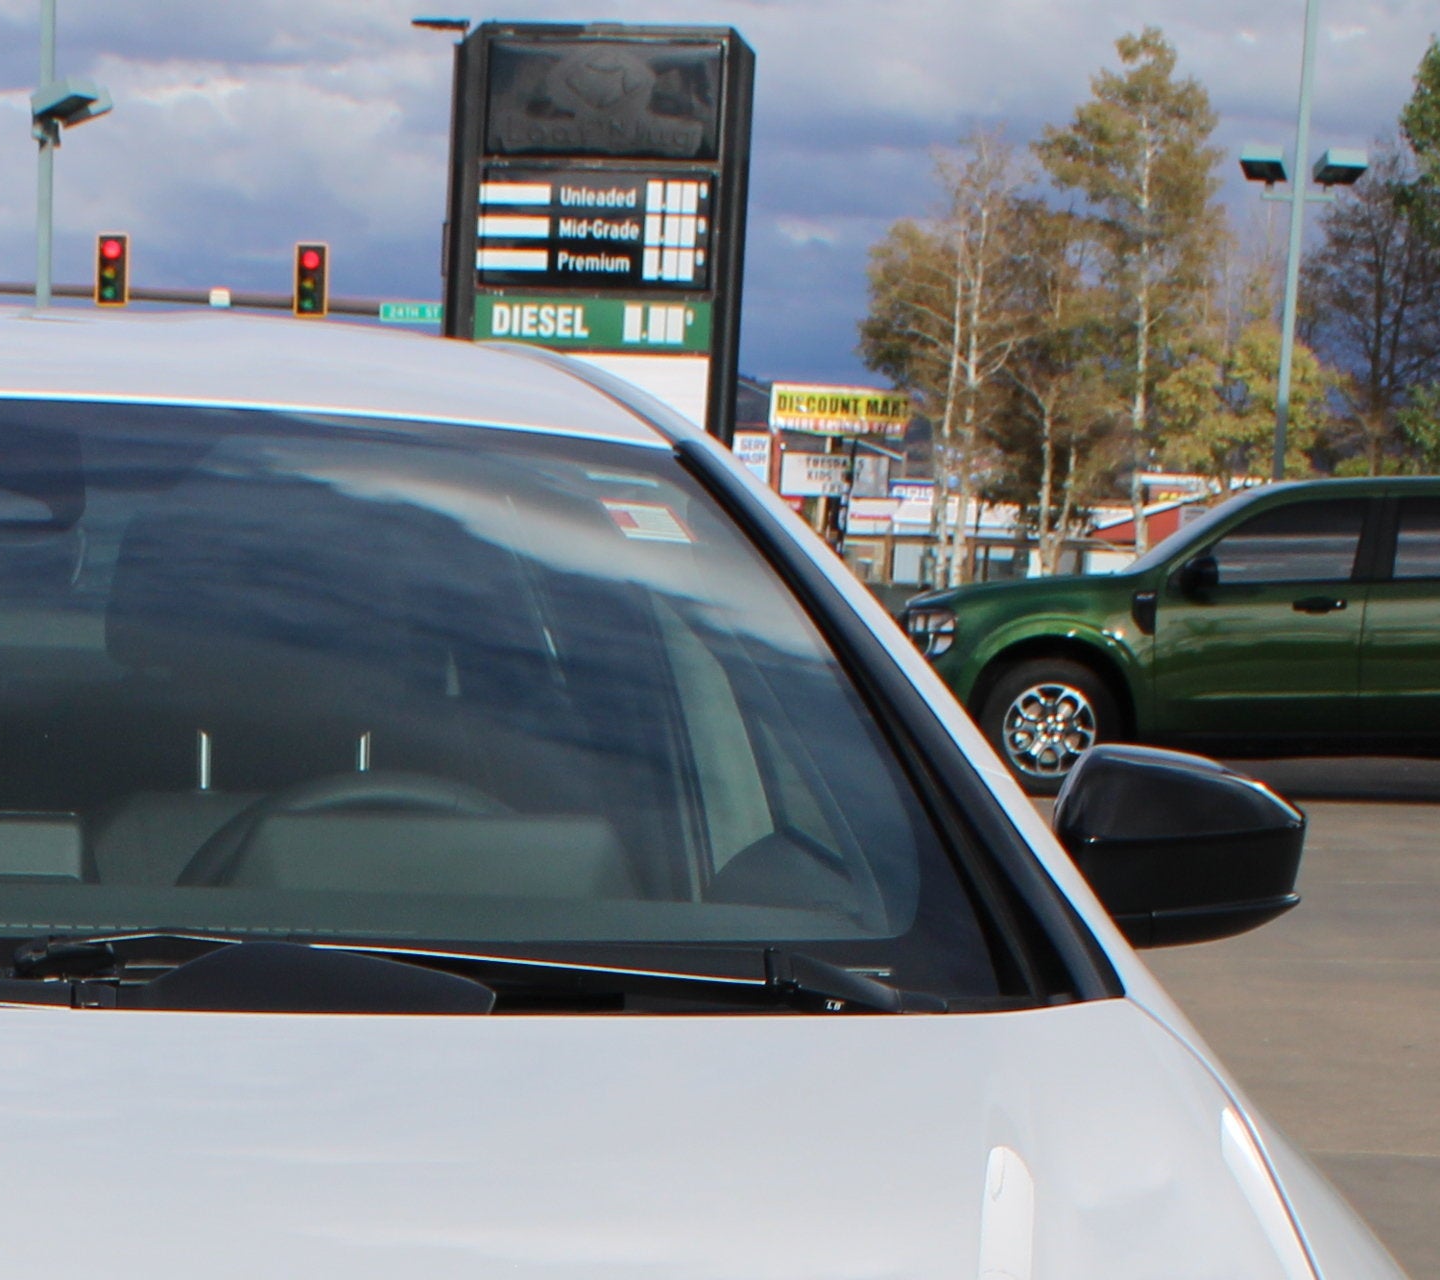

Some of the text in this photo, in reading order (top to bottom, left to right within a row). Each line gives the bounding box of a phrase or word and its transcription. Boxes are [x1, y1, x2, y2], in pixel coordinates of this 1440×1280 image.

[560, 186, 637, 208] Unleaded
[558, 216, 641, 241] Mid-Grade
[557, 250, 631, 273] Premium
[491, 303, 590, 339] DIESEL
[806, 456, 865, 471] TUESDAS
